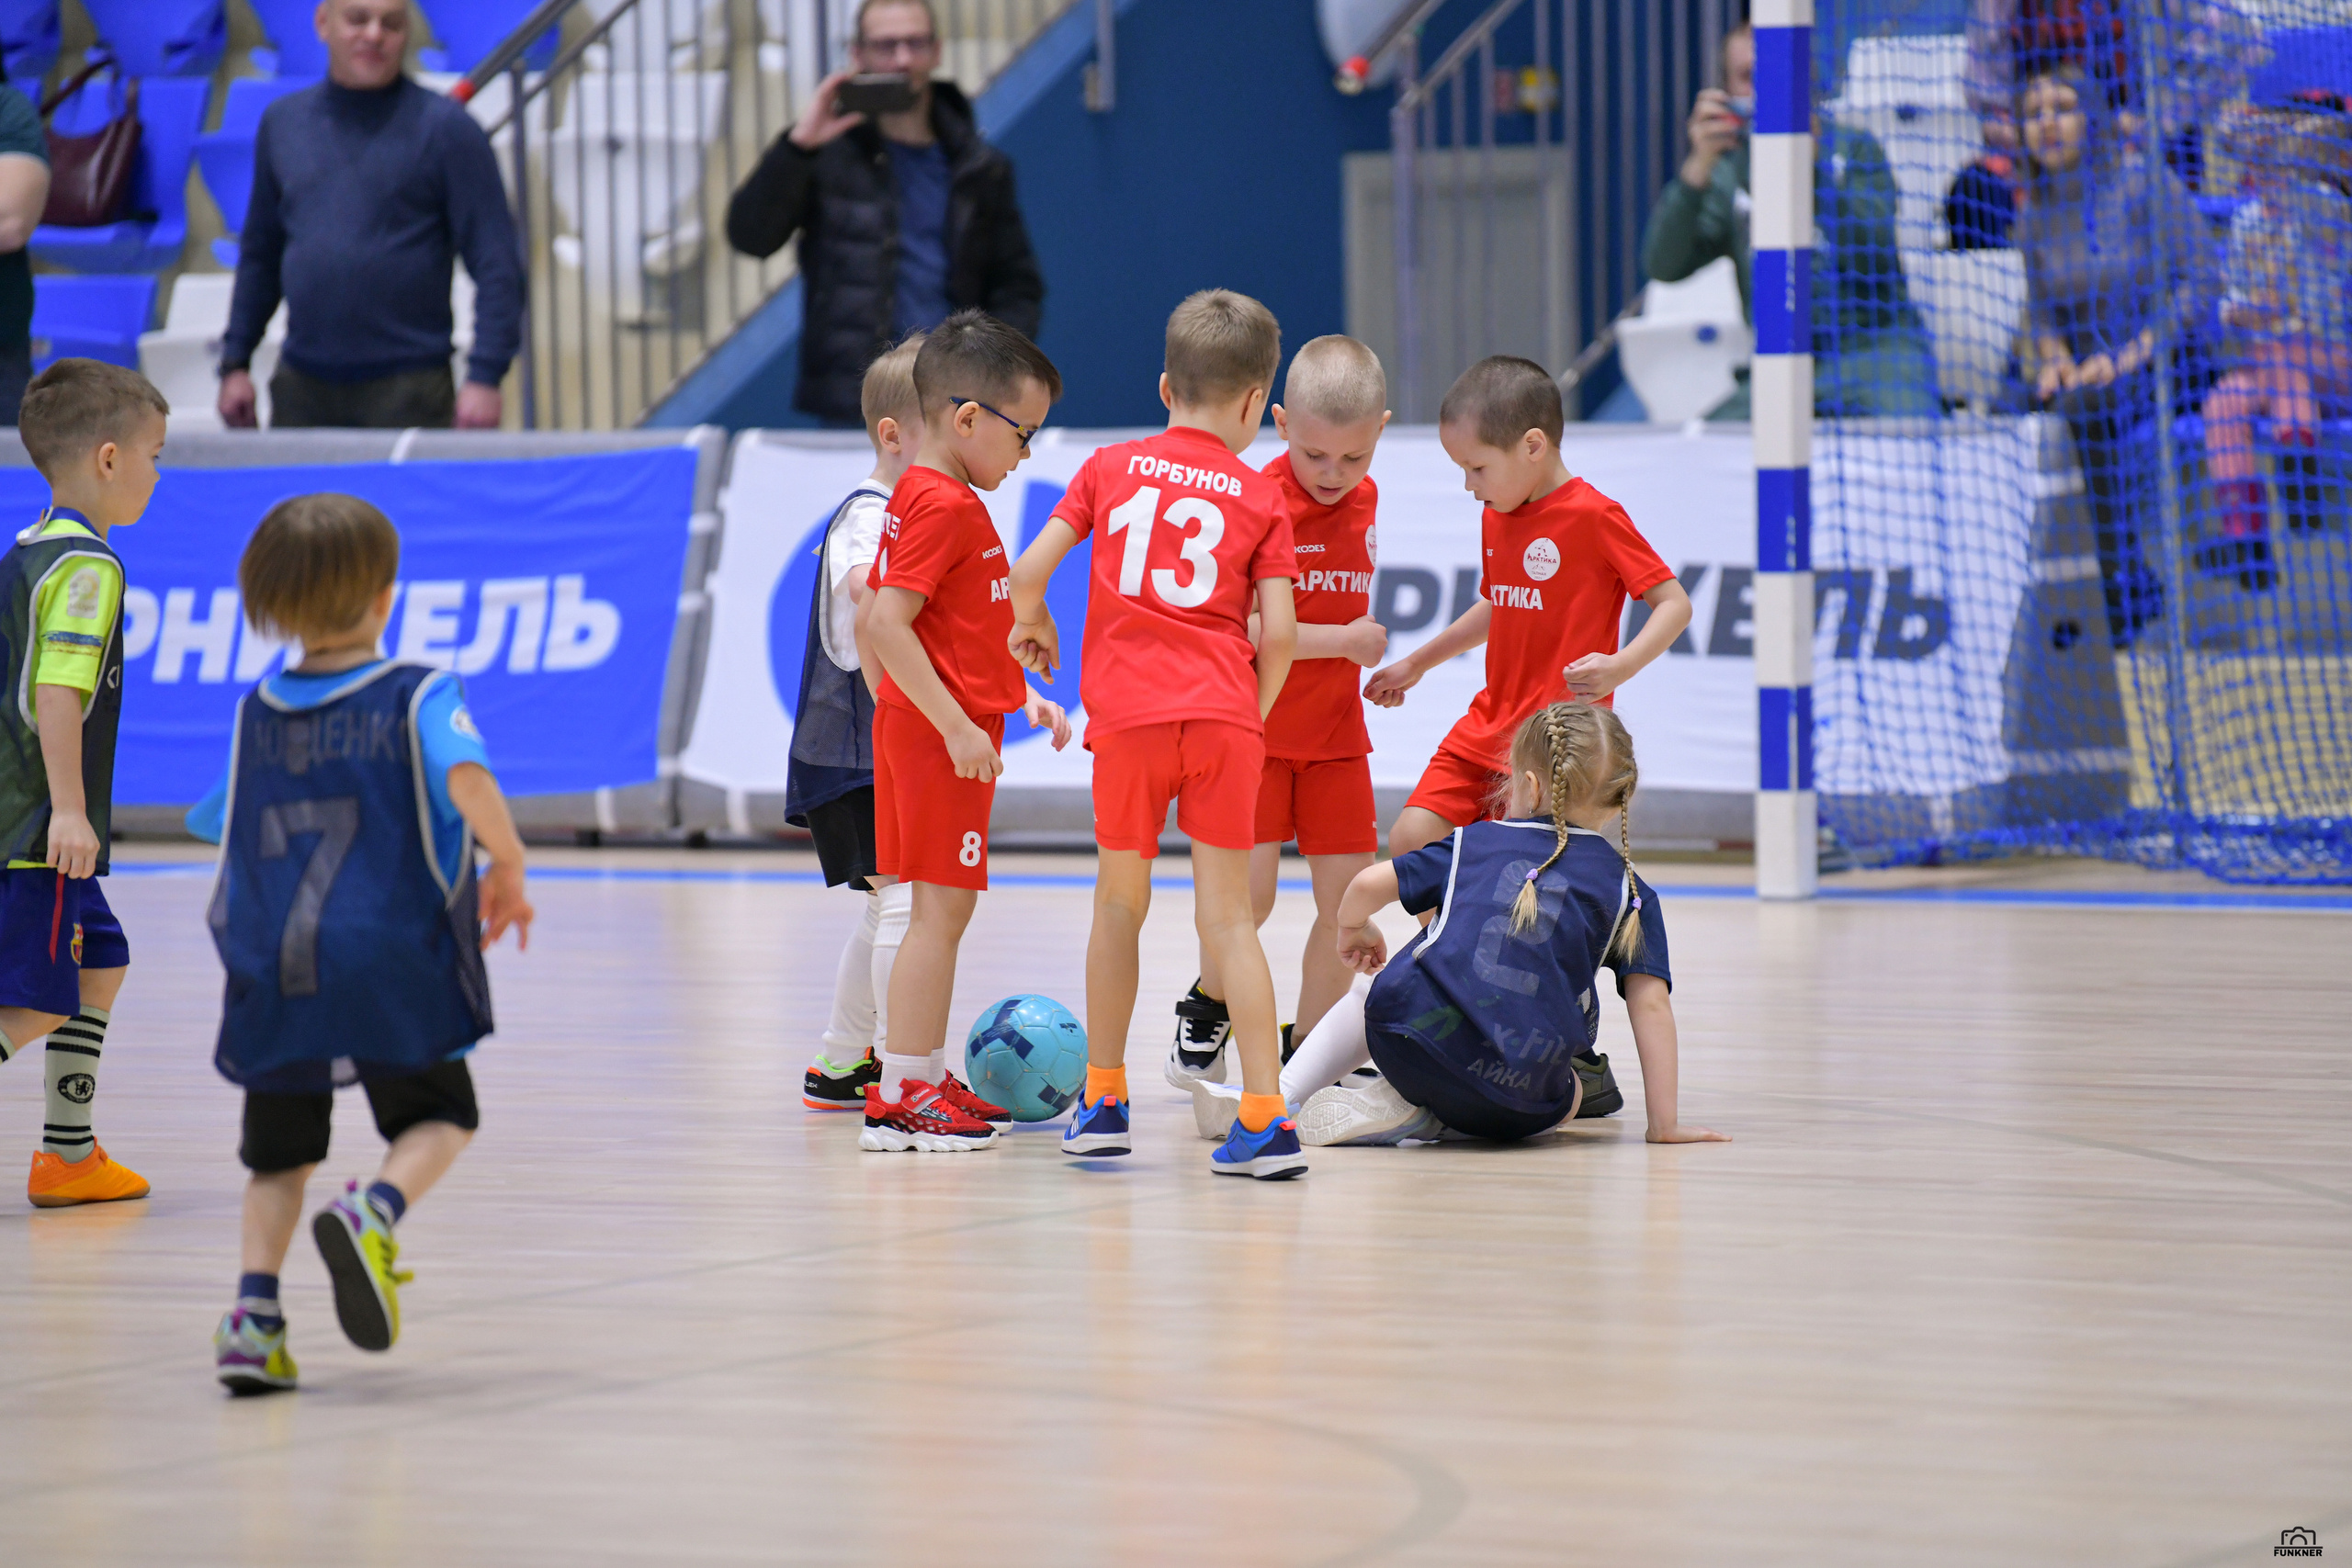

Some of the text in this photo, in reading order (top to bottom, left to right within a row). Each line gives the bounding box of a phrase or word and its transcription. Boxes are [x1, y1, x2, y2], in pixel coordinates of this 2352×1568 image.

[1127, 455, 1242, 497] ГОРБУНОВ
[1107, 485, 1226, 608] 13
[958, 830, 982, 867] 8
[259, 795, 359, 996] 7
